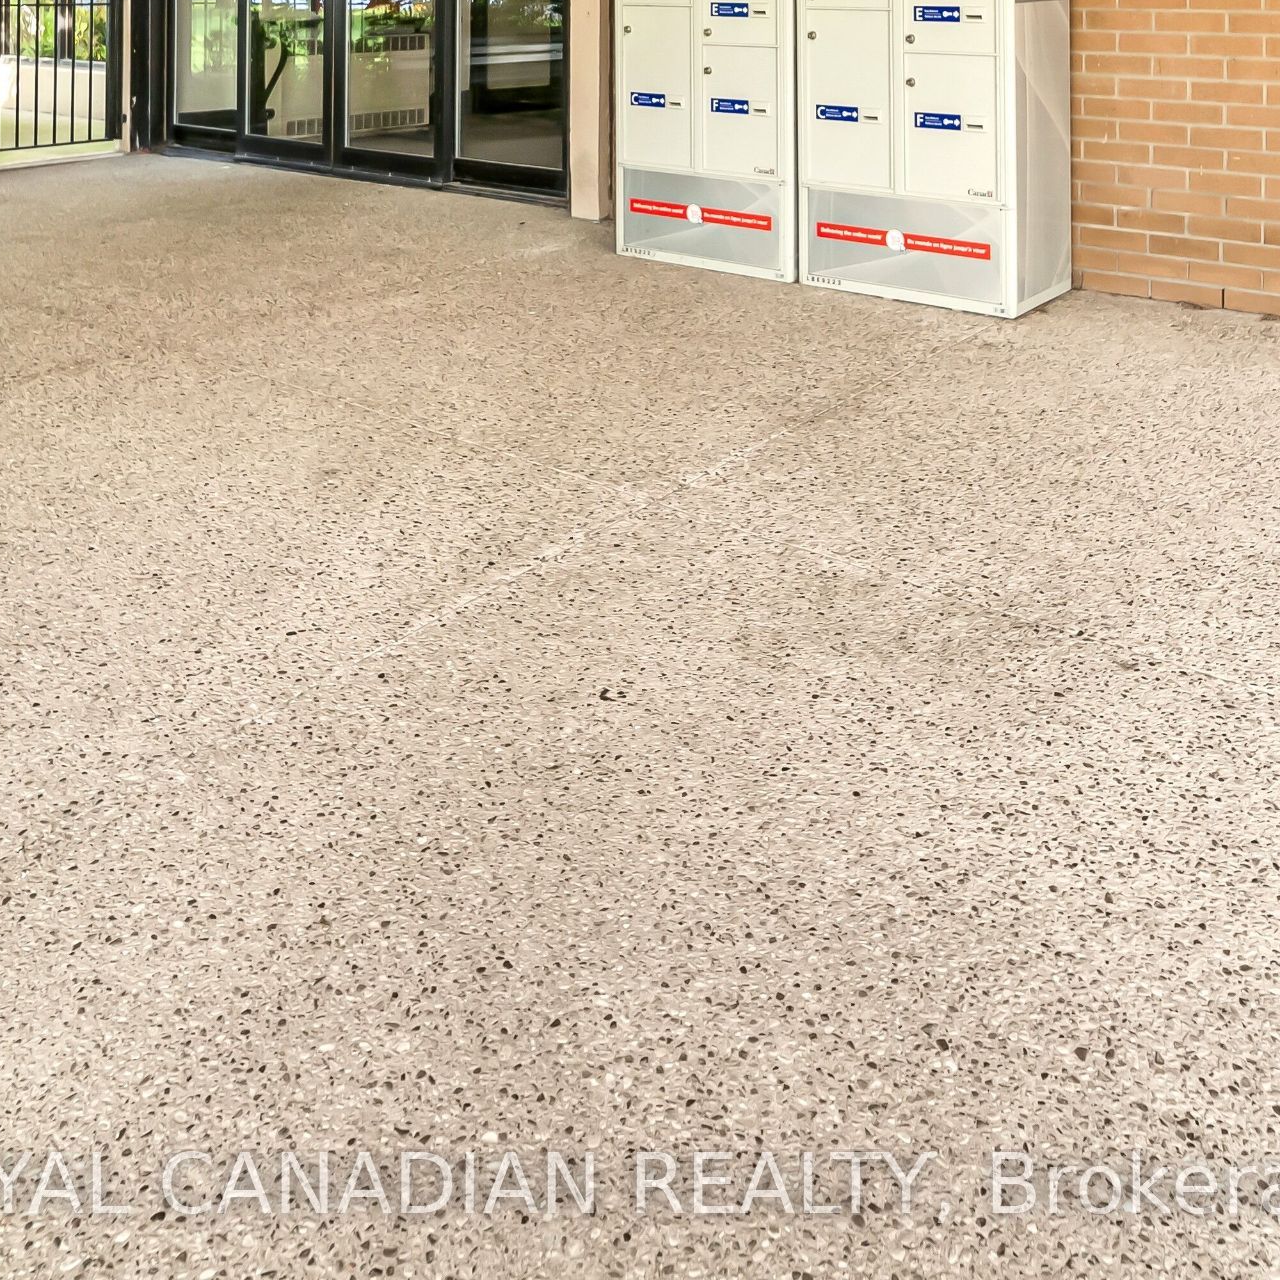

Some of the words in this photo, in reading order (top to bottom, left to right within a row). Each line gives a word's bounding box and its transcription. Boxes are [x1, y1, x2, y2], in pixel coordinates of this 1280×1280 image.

[712, 4, 719, 15] E
[916, 8, 923, 20] E
[631, 94, 638, 104] C
[713, 100, 719, 110] F
[817, 107, 826, 118] C
[916, 115, 924, 126] F
